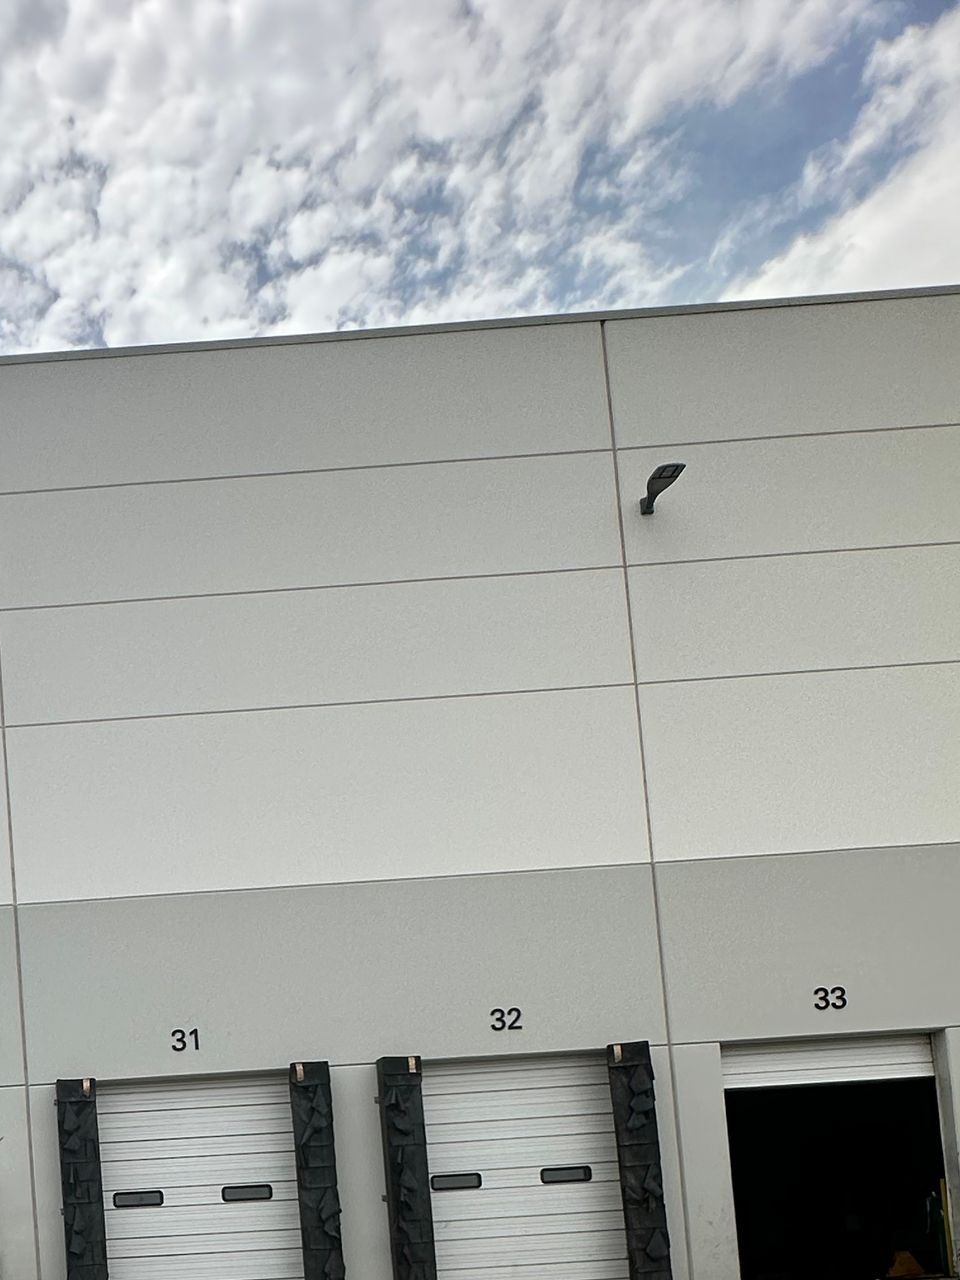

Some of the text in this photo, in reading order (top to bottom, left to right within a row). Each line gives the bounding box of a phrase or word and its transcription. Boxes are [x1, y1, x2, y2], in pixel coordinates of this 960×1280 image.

[814, 986, 848, 1012] 33
[490, 1007, 523, 1032] 32
[171, 1028, 199, 1053] 31
